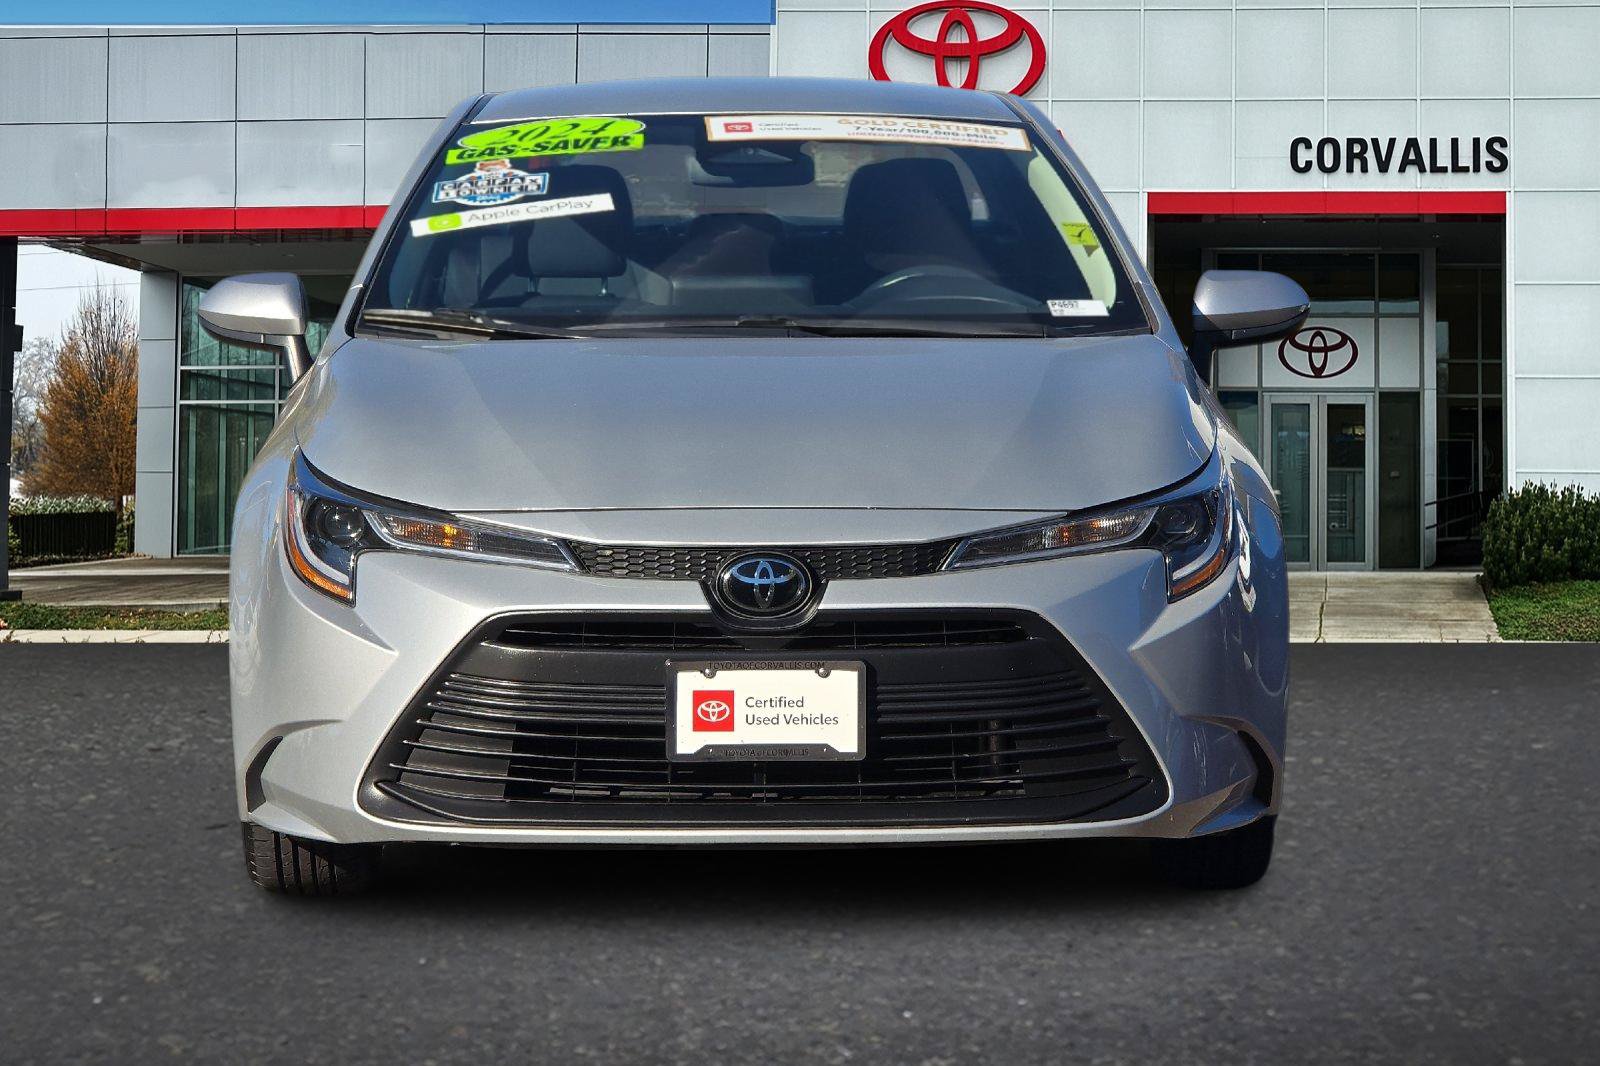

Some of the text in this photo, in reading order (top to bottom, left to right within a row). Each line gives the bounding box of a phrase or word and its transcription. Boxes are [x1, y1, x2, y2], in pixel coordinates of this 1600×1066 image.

[837, 118, 1009, 136] GOLD CERTIFIED
[1289, 136, 1509, 174] CORVALLIS
[467, 199, 594, 223] Apple CarPlay
[745, 696, 805, 708] Certified
[745, 713, 839, 725] Used Vehicles
